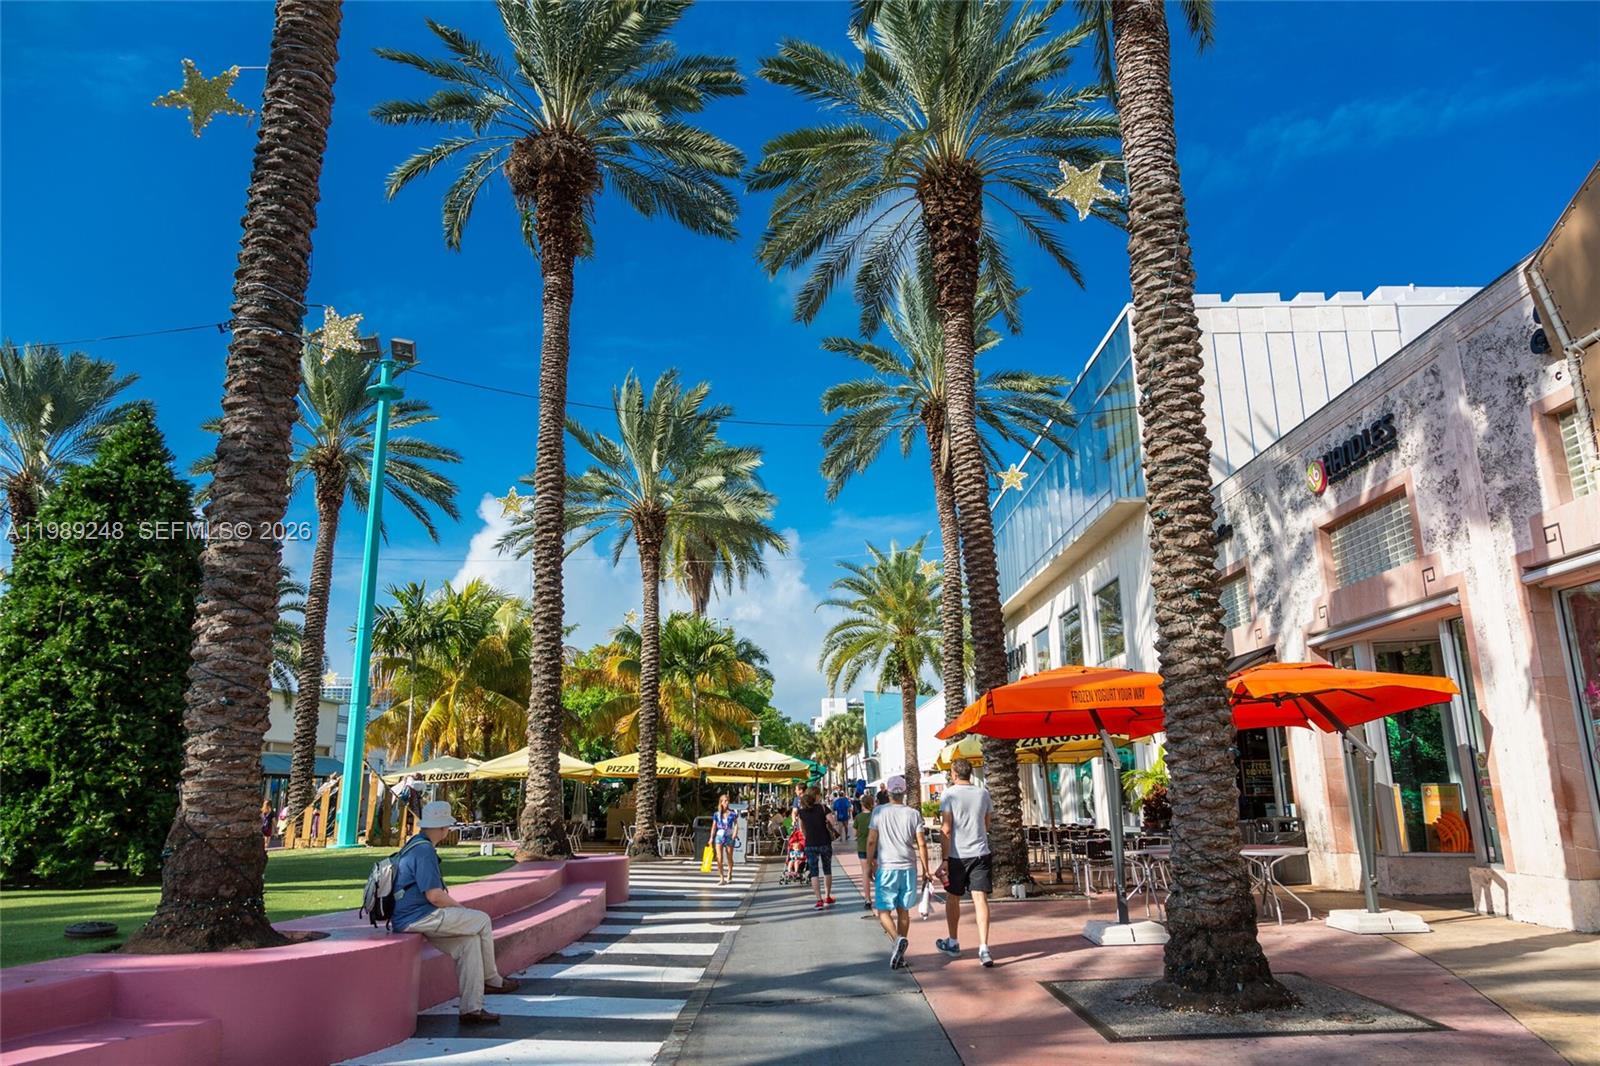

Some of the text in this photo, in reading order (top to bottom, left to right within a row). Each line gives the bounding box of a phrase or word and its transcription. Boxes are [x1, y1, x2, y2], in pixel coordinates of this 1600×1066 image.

[1071, 687, 1146, 704] FROZEN YOGURT YOUR WAY
[605, 765, 636, 773] PIZZA
[717, 760, 791, 771] PIZZA RUSTICA
